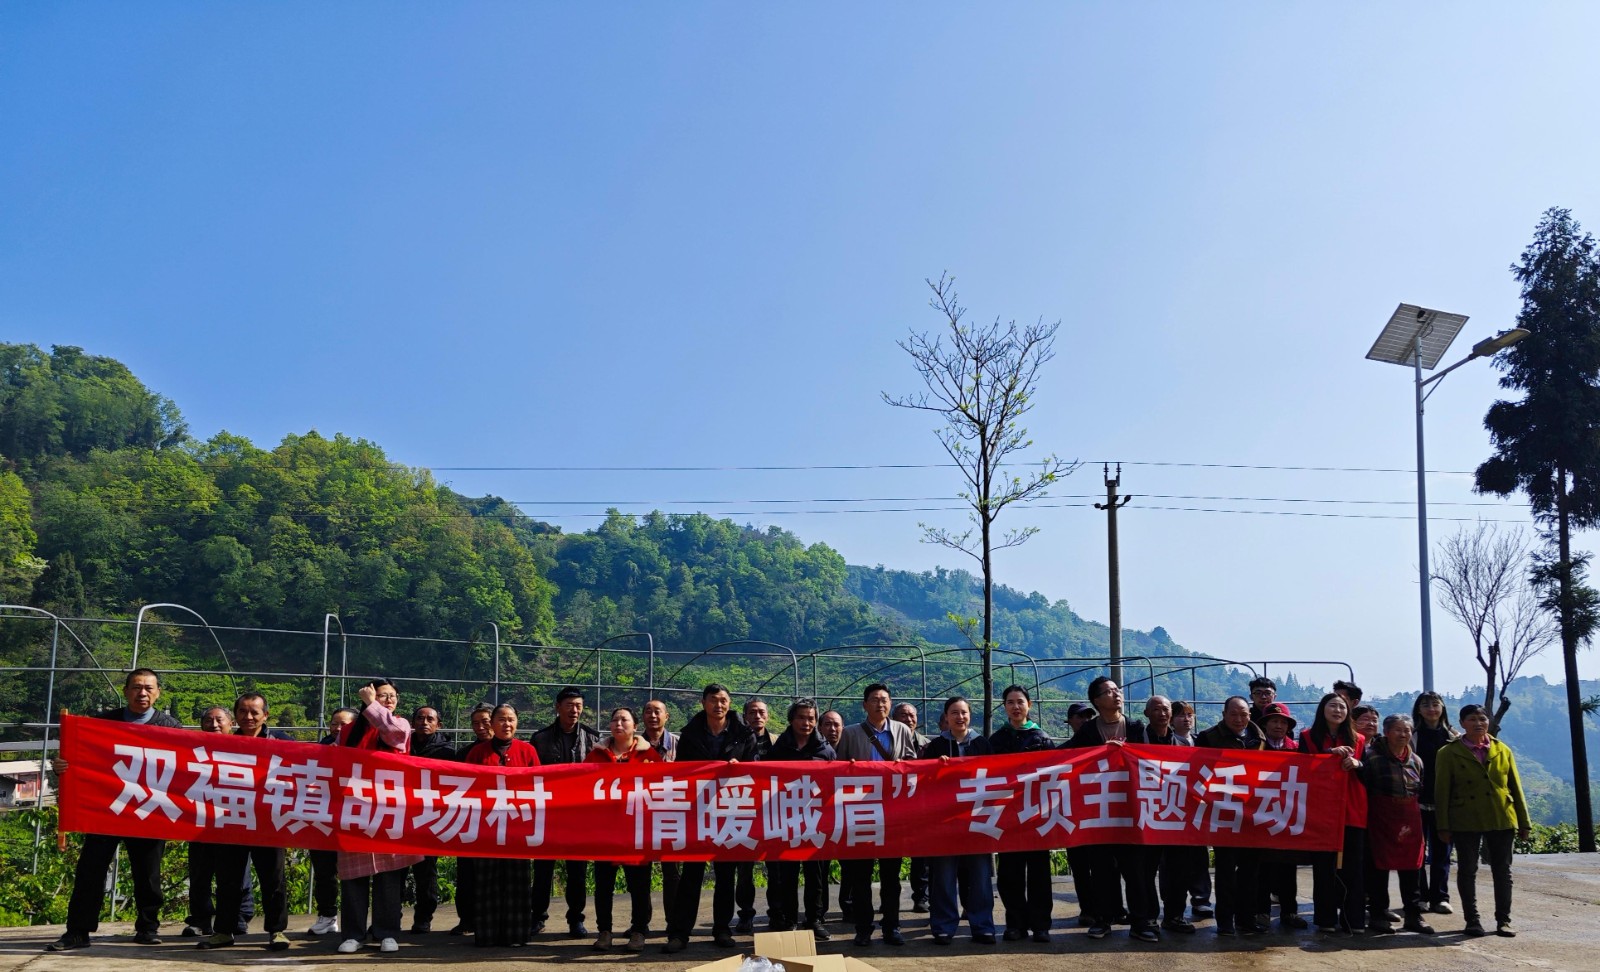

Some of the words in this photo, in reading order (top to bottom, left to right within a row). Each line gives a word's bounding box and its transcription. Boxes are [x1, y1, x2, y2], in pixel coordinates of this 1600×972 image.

[109, 743, 553, 847] 双福镇胡场村
[955, 759, 1308, 840] 专项主题活动
